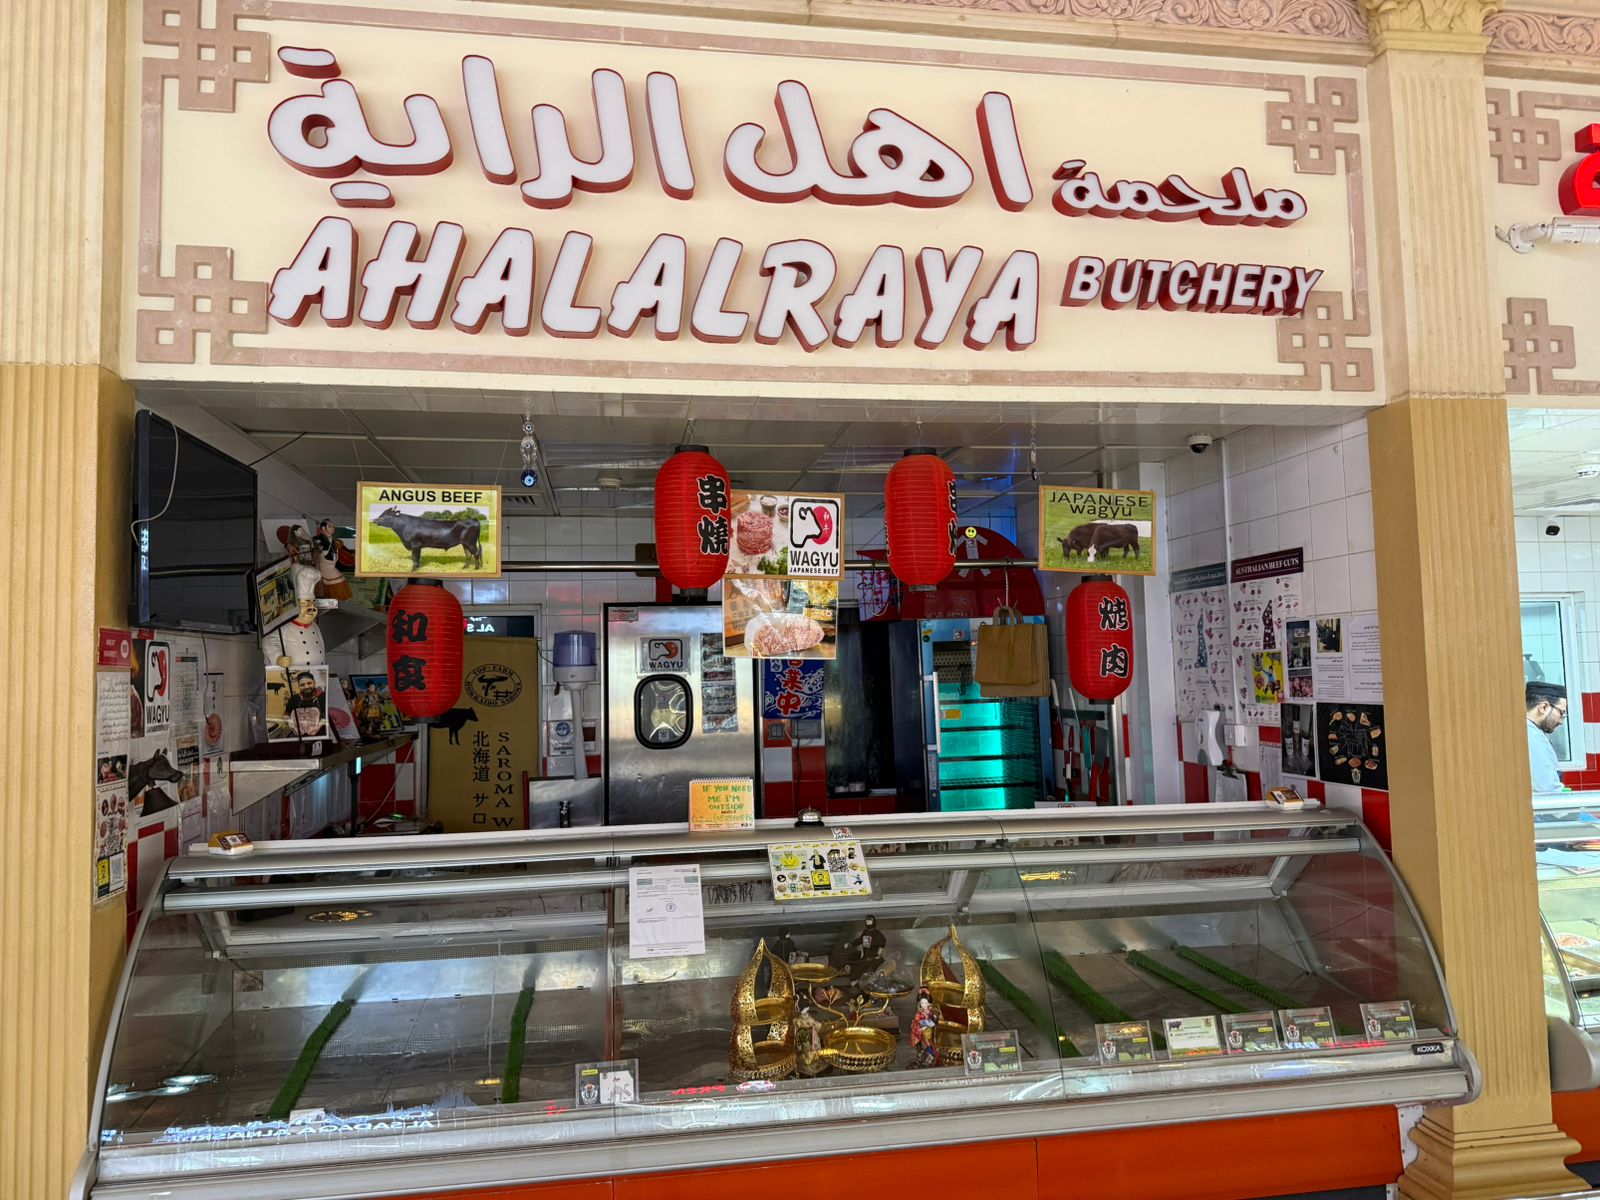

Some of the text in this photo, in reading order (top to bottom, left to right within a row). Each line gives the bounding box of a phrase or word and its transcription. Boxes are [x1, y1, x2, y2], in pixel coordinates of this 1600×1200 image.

[267, 45, 1308, 228] ملحمة اهل الراية
[267, 215, 1324, 351] AHALALRAYA BUTCHERY
[379, 489, 483, 504] ANGUS BEEF
[1049, 491, 1149, 508] JAPANESE
[1069, 504, 1132, 519] wagyu
[790, 551, 839, 568] WAGYU
[1269, 560, 1283, 570] BEEF
[1283, 557, 1300, 567] CUTS
[789, 567, 822, 575] JAPANESE
[649, 661, 684, 669] WAGYU
[146, 704, 171, 725] WAGYU
[472, 731, 490, 782] 北海道
[494, 732, 514, 808] SAROMA
